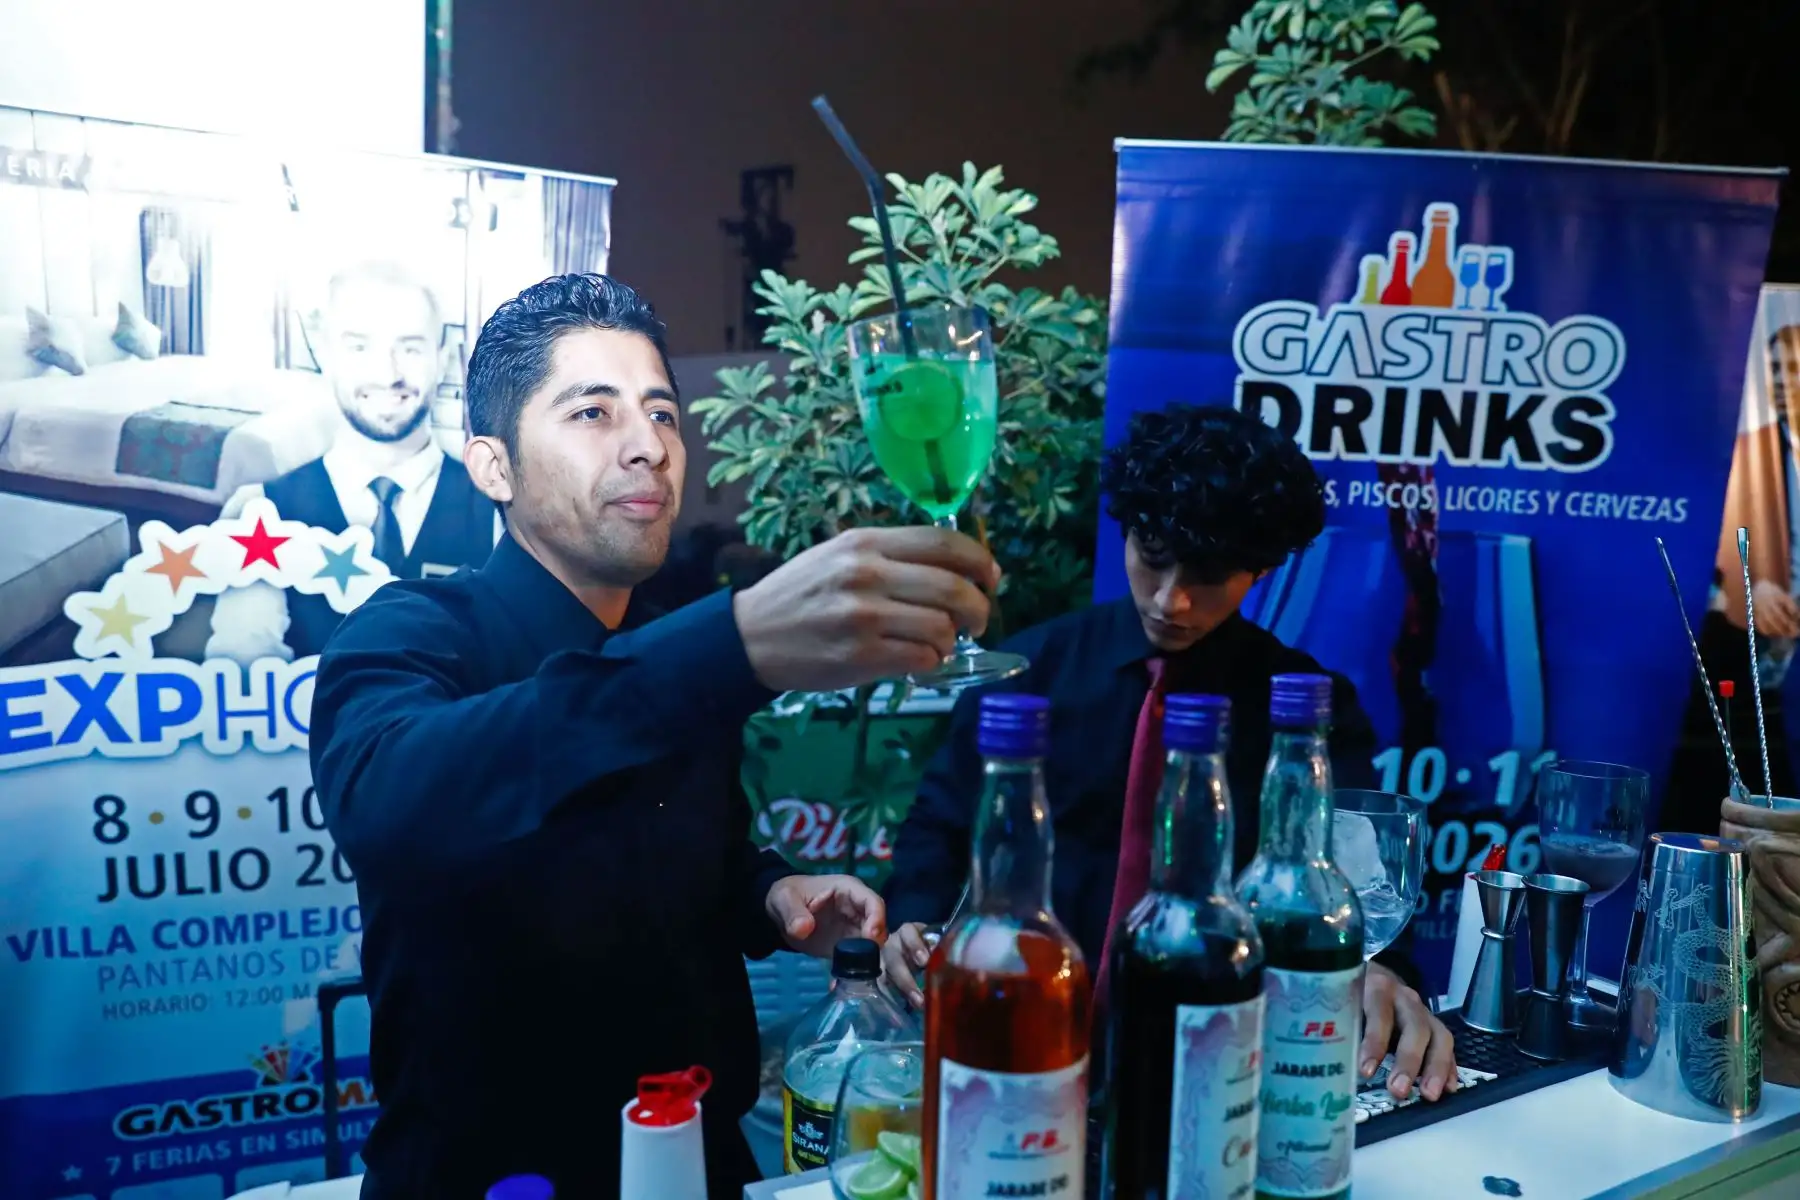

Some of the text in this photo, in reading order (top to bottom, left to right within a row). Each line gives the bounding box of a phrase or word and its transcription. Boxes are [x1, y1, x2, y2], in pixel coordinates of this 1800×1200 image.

[1240, 309, 1619, 391] GASTRO
[1239, 380, 1608, 464] DRINKS
[1445, 485, 1540, 515] LICORES
[1546, 492, 1560, 515] Y
[1565, 491, 1690, 523] CERVEZAS
[1371, 747, 1447, 804] 10
[97, 843, 356, 903] JULIO 20
[1426, 820, 1542, 876] 026
[6, 924, 137, 962] VILLA
[97, 950, 285, 992] PANTANOS
[301, 945, 340, 974] DE
[105, 1156, 121, 1176] 7
[133, 1139, 231, 1172] FERIAS
[241, 1133, 276, 1155] EN
